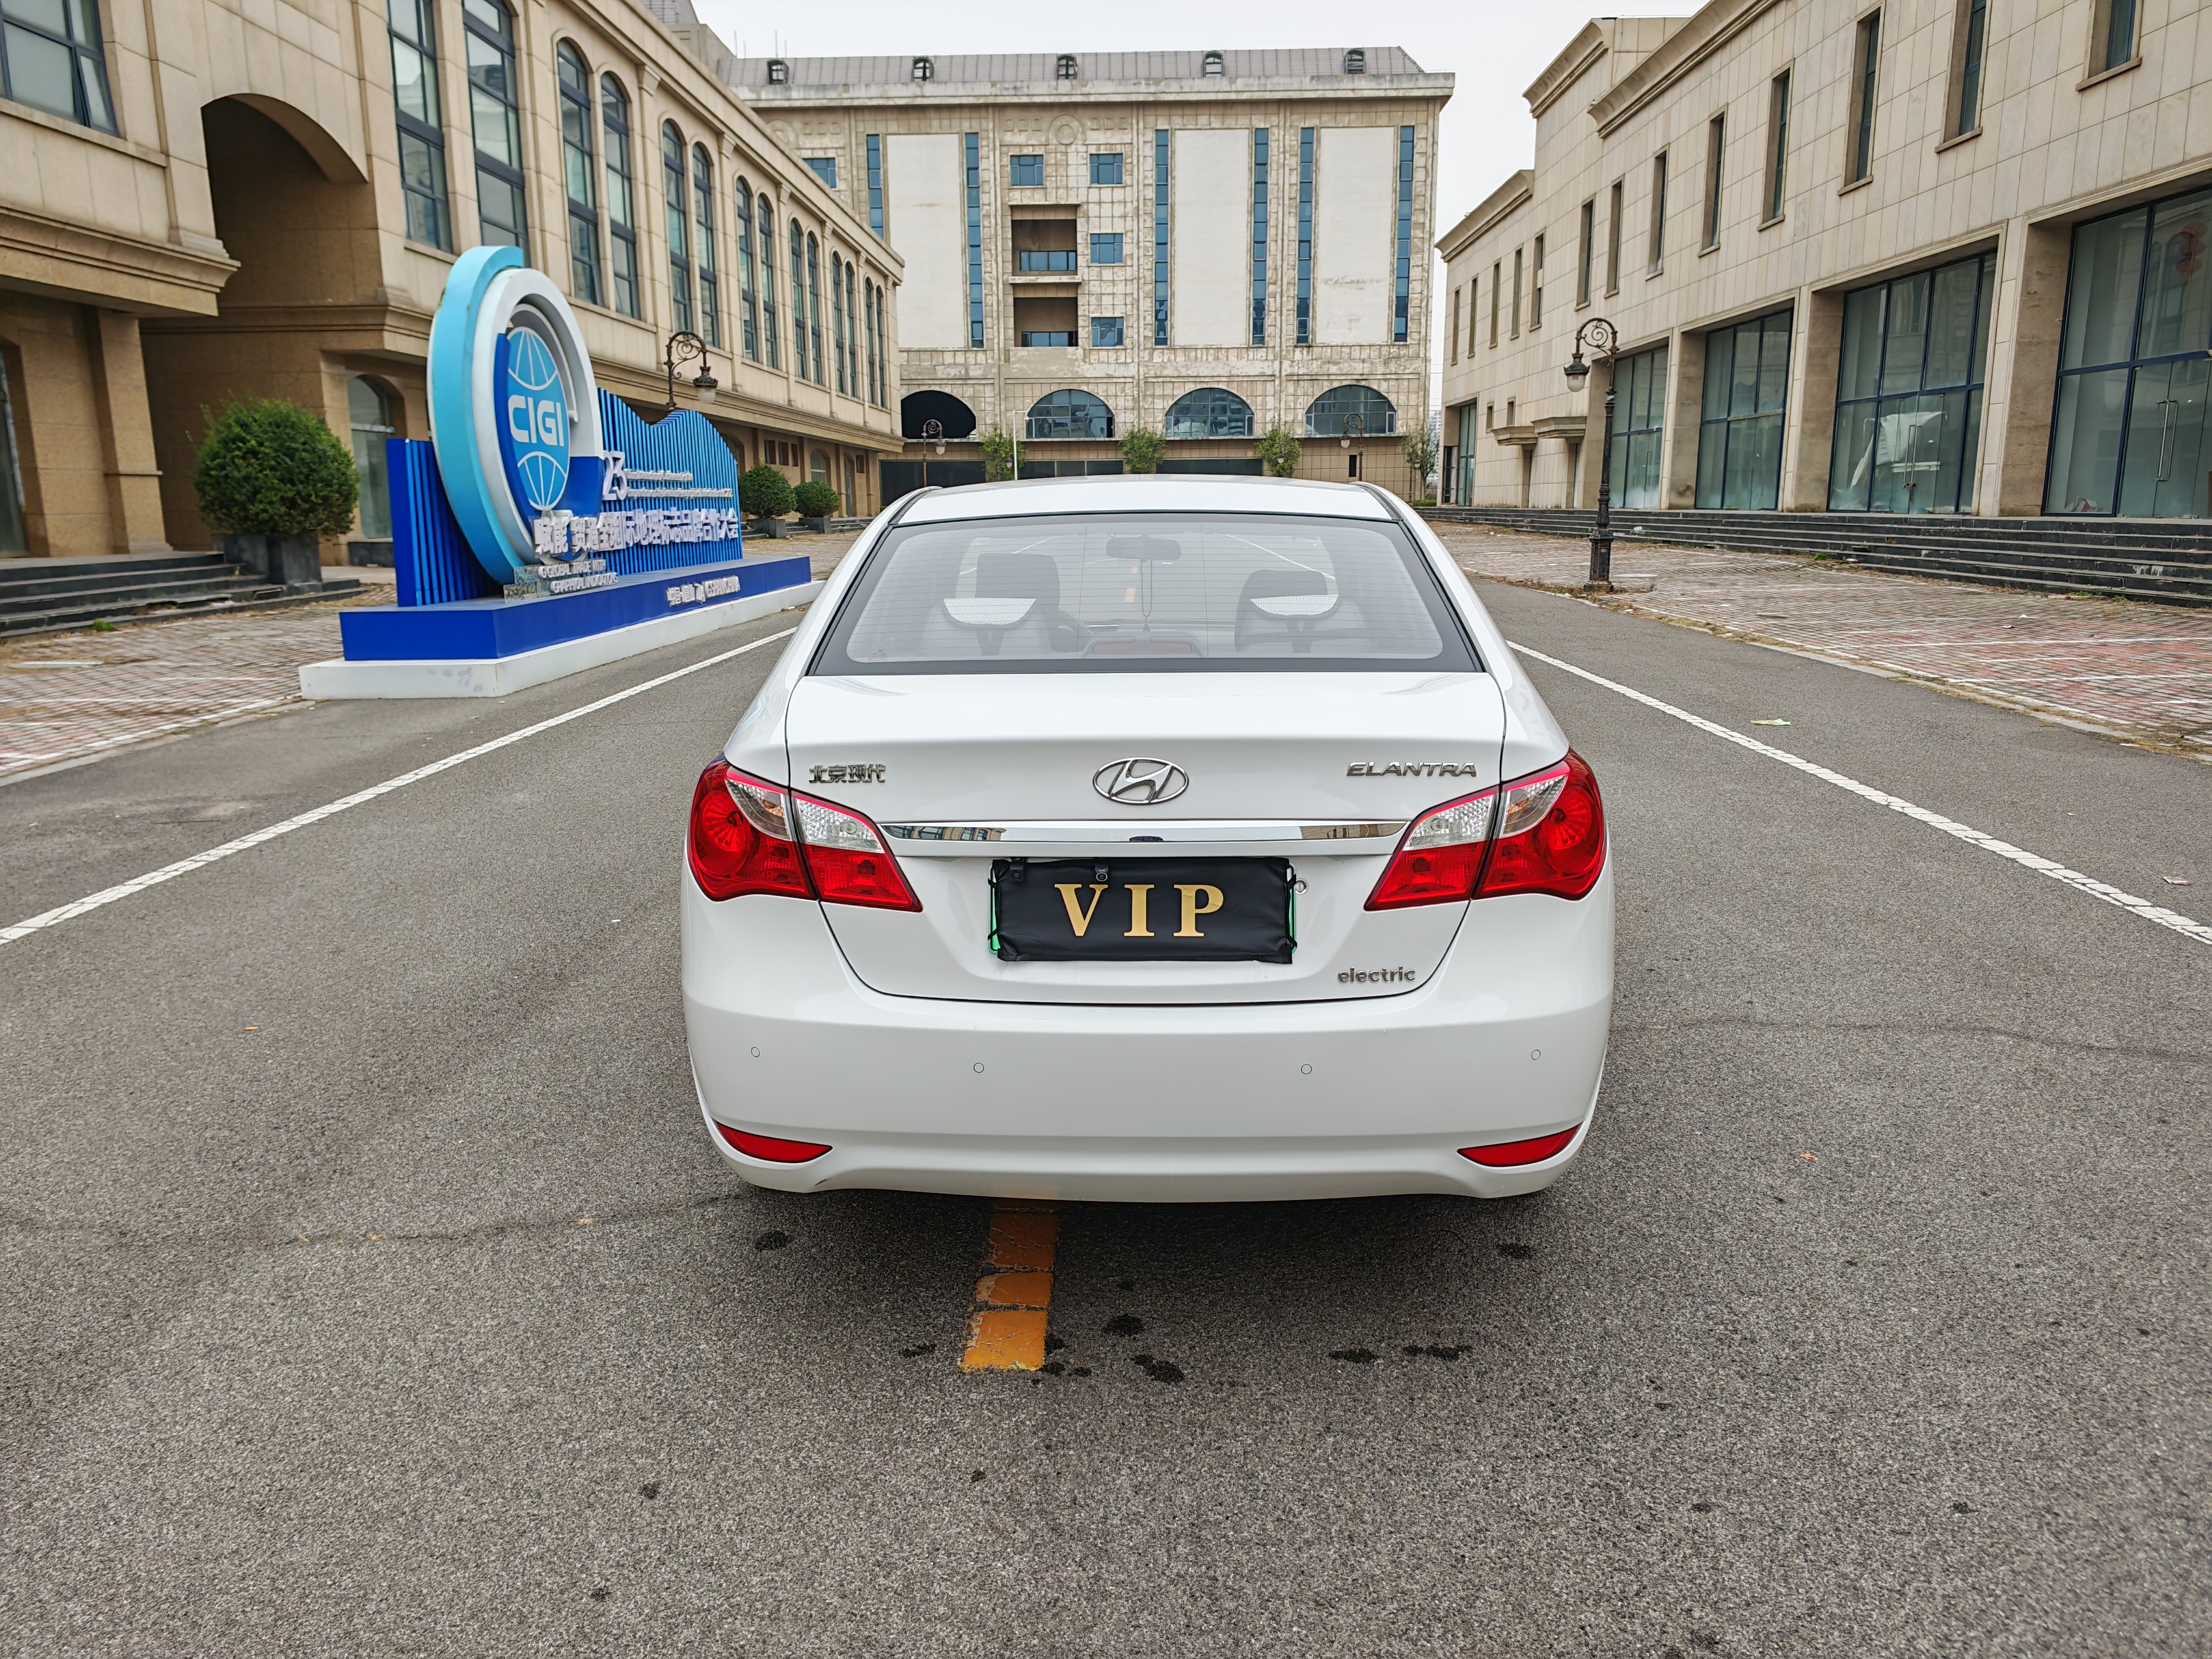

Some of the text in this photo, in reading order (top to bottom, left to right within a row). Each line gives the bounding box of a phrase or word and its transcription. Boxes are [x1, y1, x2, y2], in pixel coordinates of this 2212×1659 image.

[508, 395, 564, 447] CIGI
[809, 764, 886, 783] 北京现代
[1346, 761, 1476, 777] ELANTRA
[1054, 884, 1224, 937] VIP
[1337, 965, 1416, 983] electric
